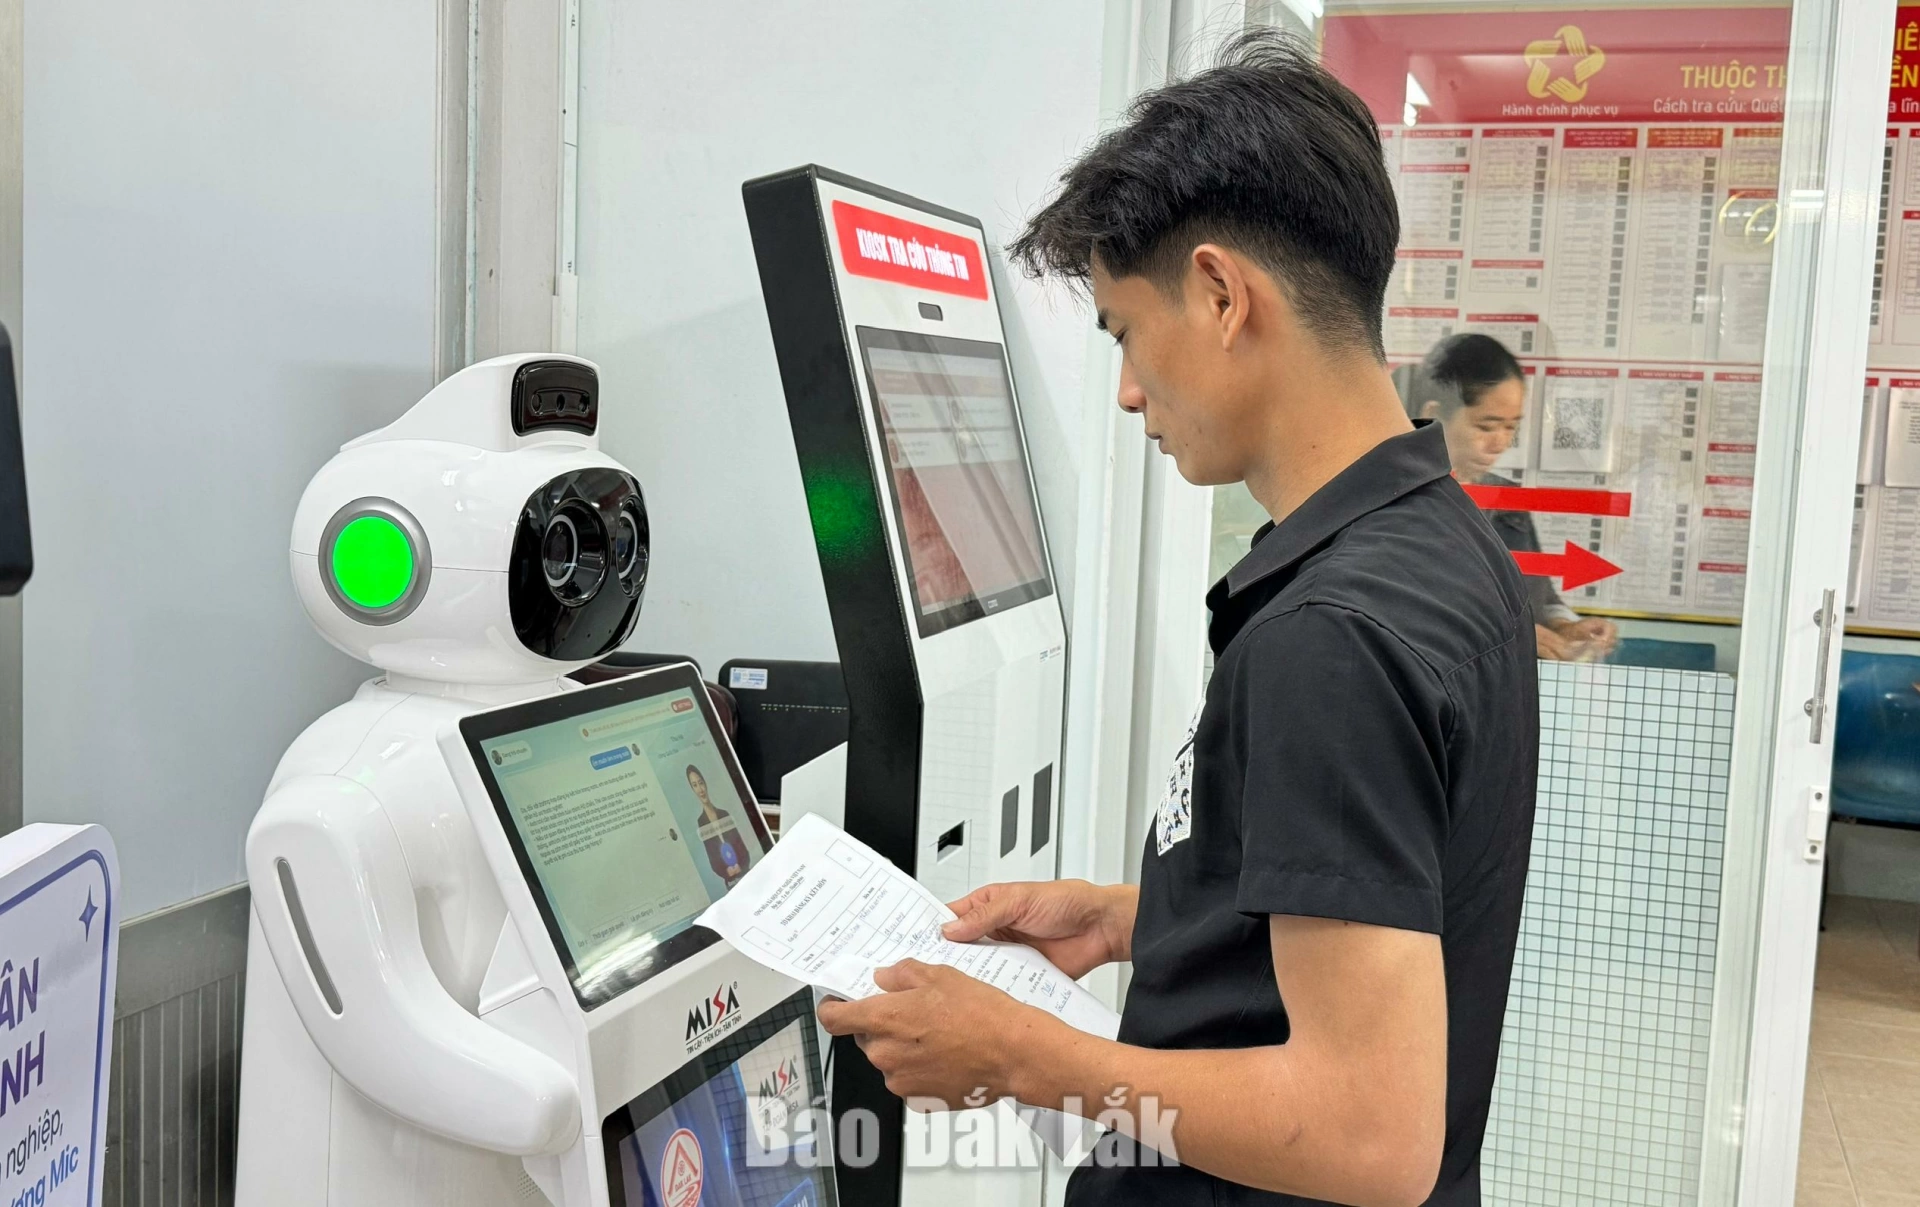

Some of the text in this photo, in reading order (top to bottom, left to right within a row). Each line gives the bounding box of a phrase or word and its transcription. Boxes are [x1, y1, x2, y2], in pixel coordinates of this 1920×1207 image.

[1895, 20, 1920, 51] IÊ
[1680, 60, 1756, 95] THUỘC
[1501, 103, 1619, 118] Hành chính phục vụ
[1653, 97, 1687, 113] Cách
[1692, 98, 1712, 113] tra
[1716, 96, 1747, 113] cứu:
[856, 227, 890, 263] KIOSK
[887, 235, 909, 267] TRA
[685, 983, 740, 1041] MISA
[758, 1056, 799, 1108] MISA
[6, 1108, 63, 1179] nghiệp,
[49, 1144, 79, 1194] Mic
